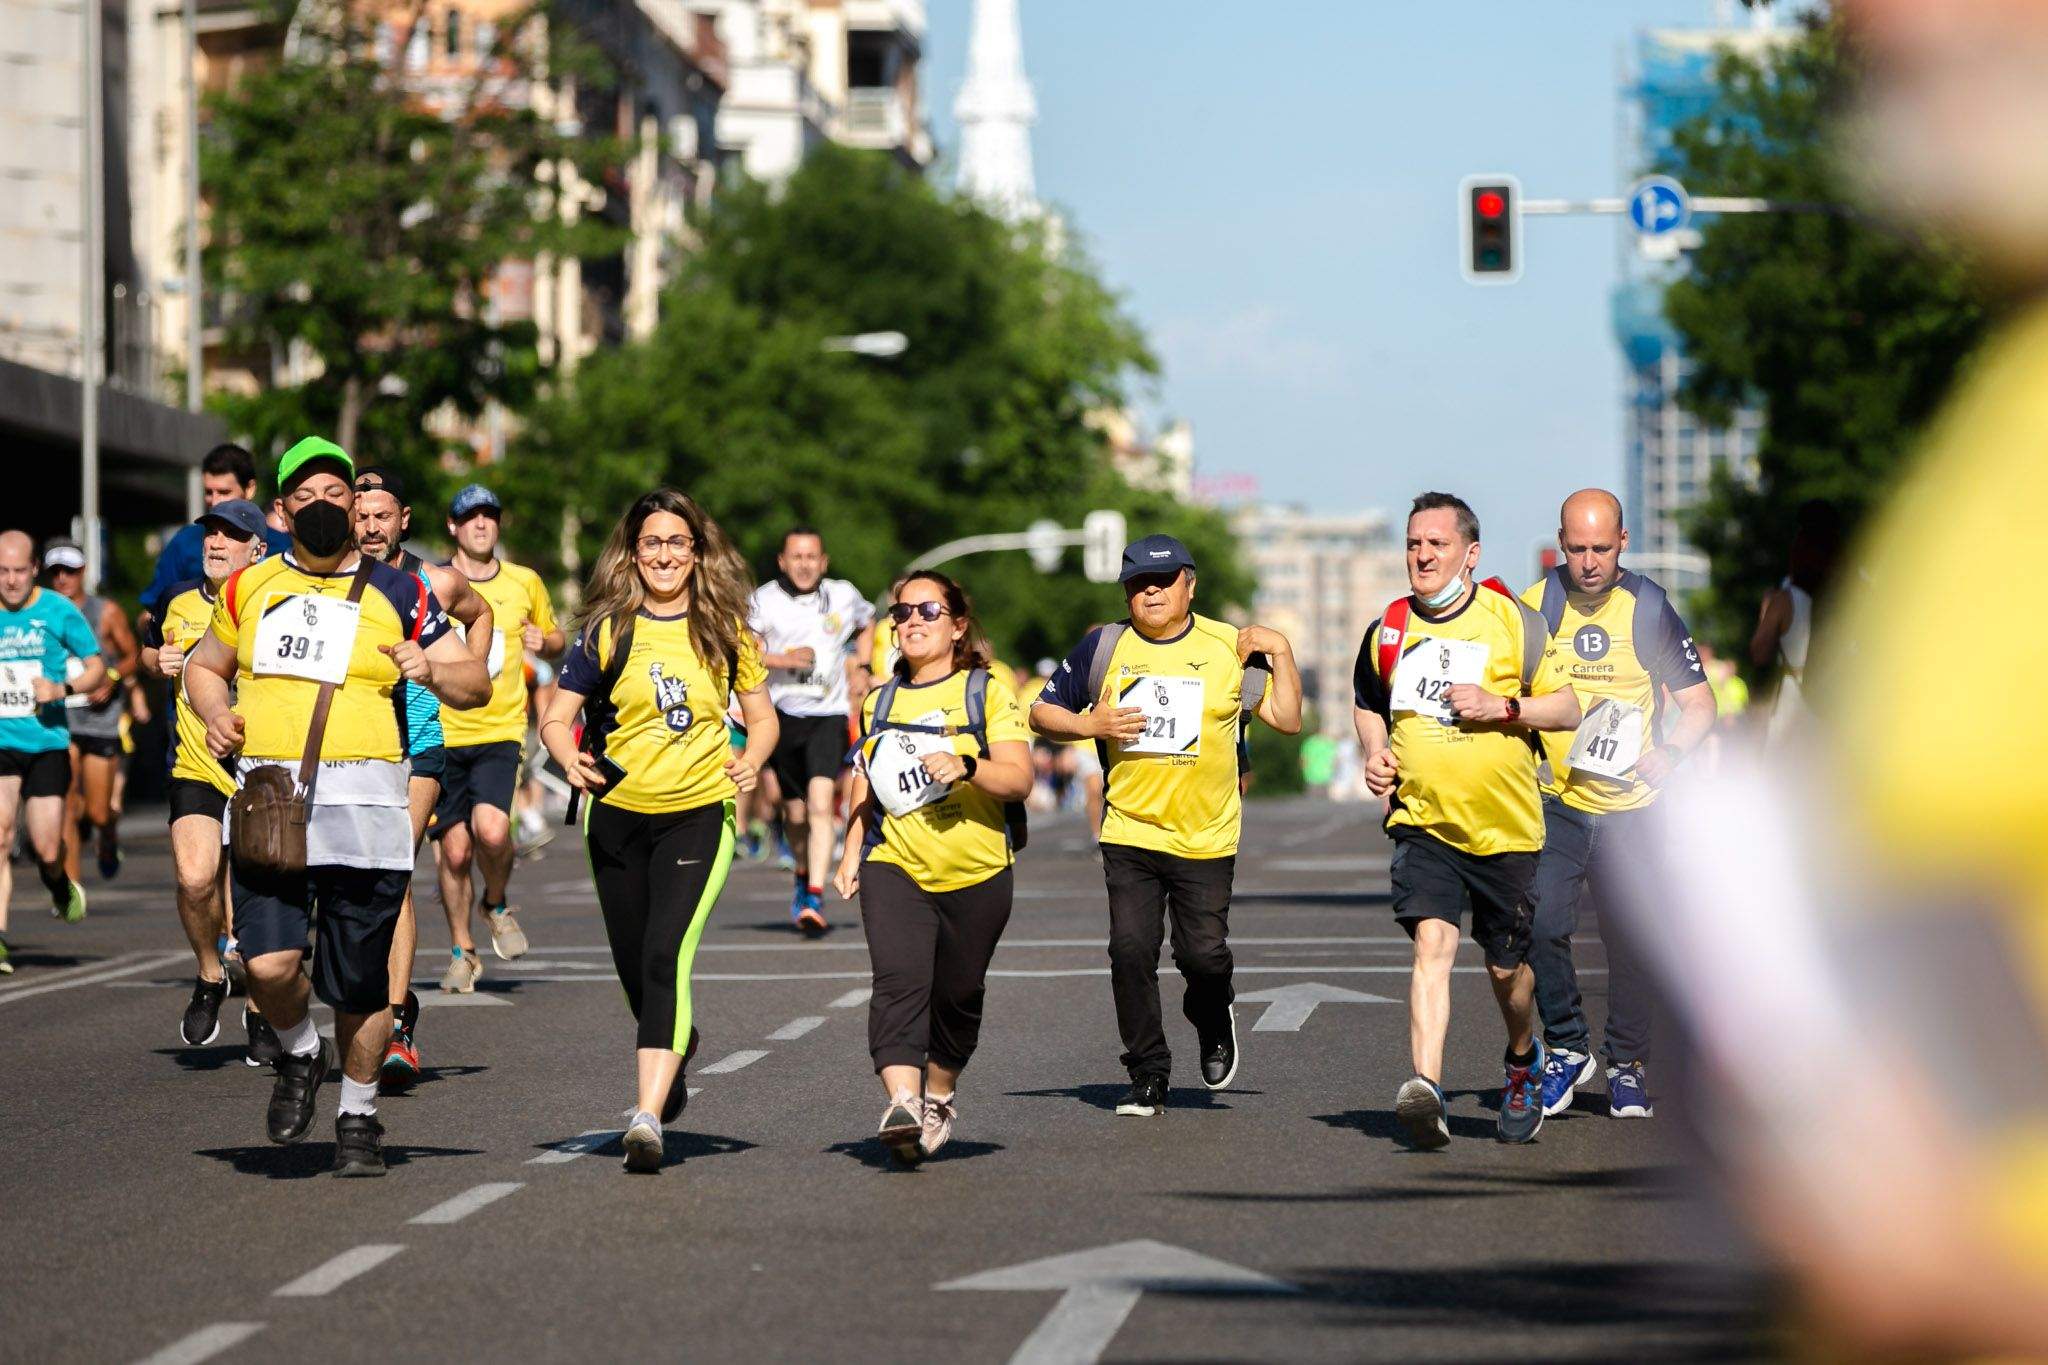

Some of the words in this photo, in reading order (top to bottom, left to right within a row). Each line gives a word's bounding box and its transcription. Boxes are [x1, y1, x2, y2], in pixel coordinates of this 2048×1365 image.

[277, 634, 325, 662] 391
[1581, 633, 1603, 652] 13
[1572, 663, 1614, 673] Carrera
[671, 709, 690, 727] 13
[1586, 735, 1619, 761] 417
[1172, 759, 1197, 767] Liberty
[898, 764, 934, 794] 418
